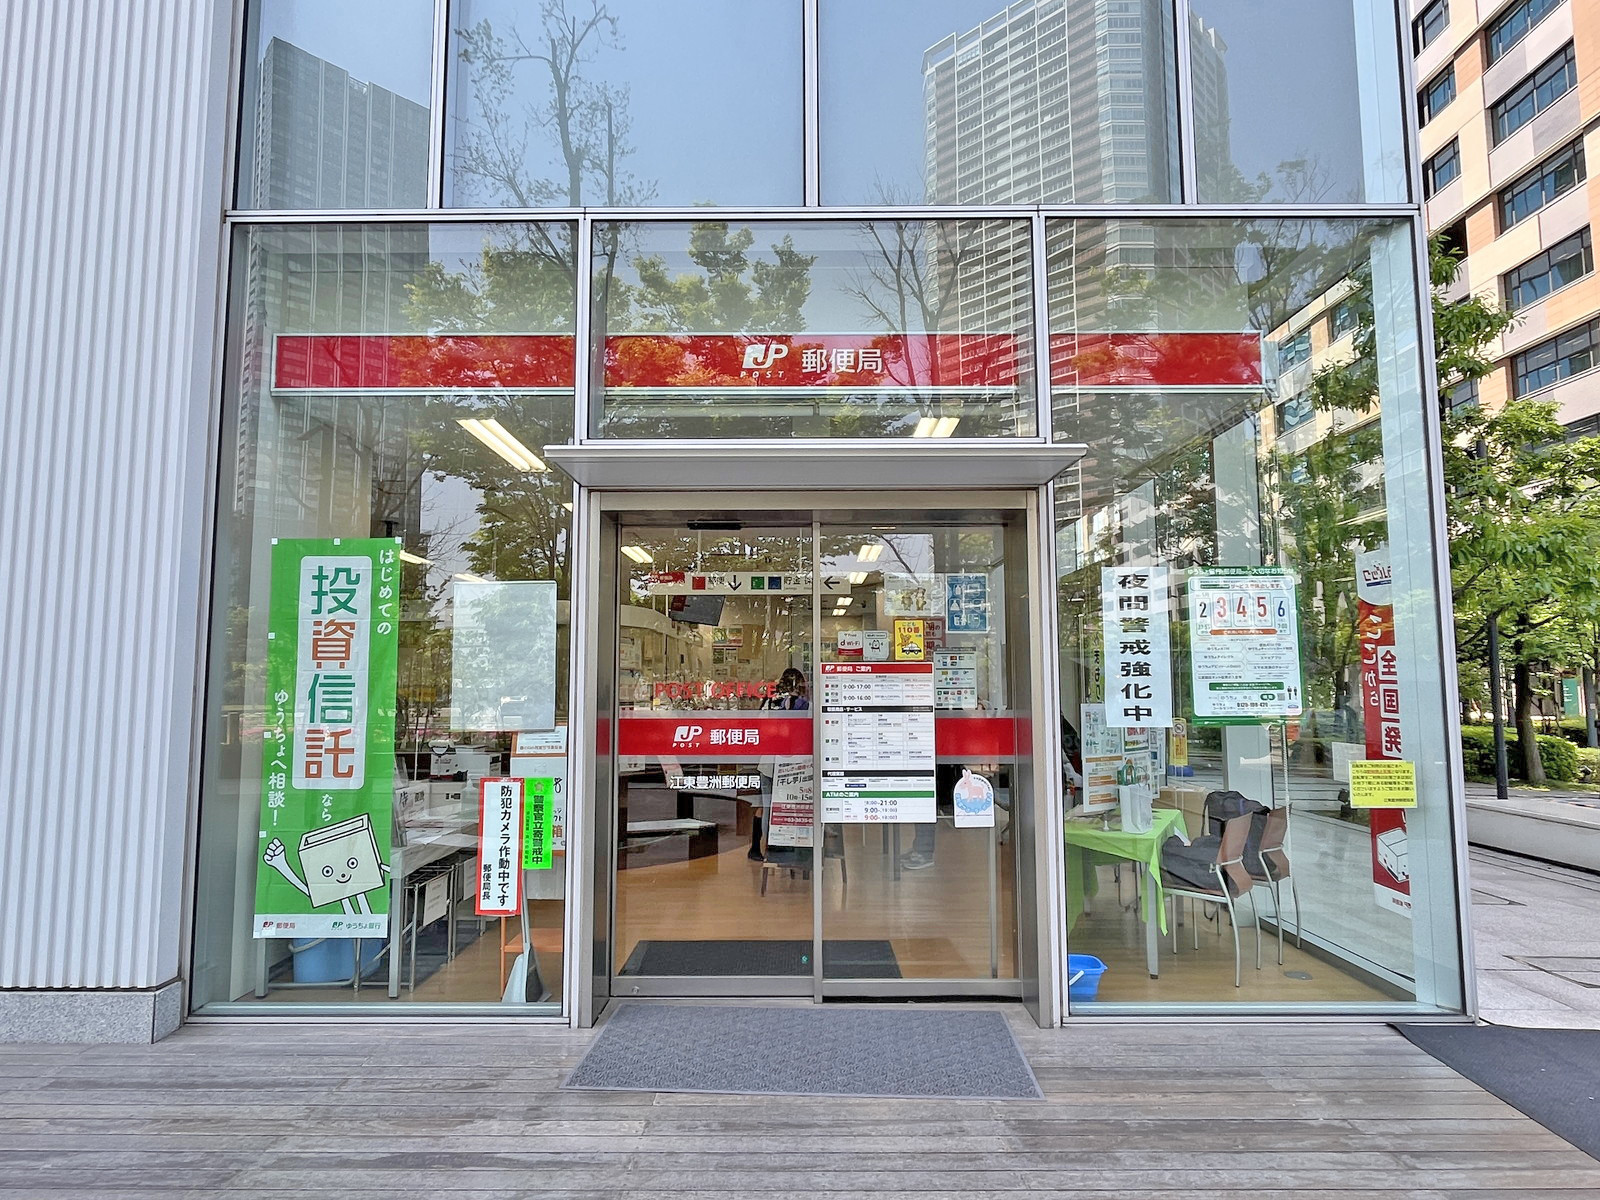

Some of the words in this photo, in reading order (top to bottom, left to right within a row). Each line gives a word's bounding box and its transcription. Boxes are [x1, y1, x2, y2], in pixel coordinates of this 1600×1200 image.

[801, 348, 884, 374] 郵便局
[377, 549, 395, 635] はじめての
[1199, 601, 1207, 618] 2
[1216, 597, 1227, 618] 3
[1236, 596, 1247, 617] 4
[1257, 596, 1267, 617] 5
[1277, 600, 1286, 617] 6
[1118, 573, 1152, 722] 夜間警戒強化中
[304, 565, 361, 779] 投資信託
[655, 682, 704, 699] POST
[711, 682, 777, 699] OFFICE
[709, 729, 760, 746] 郵便局
[669, 775, 761, 789] 江東豊洲郵便局
[321, 794, 333, 821] なら
[497, 785, 513, 907] 防犯カメラ作動中です
[482, 863, 492, 900] 郵便局長
